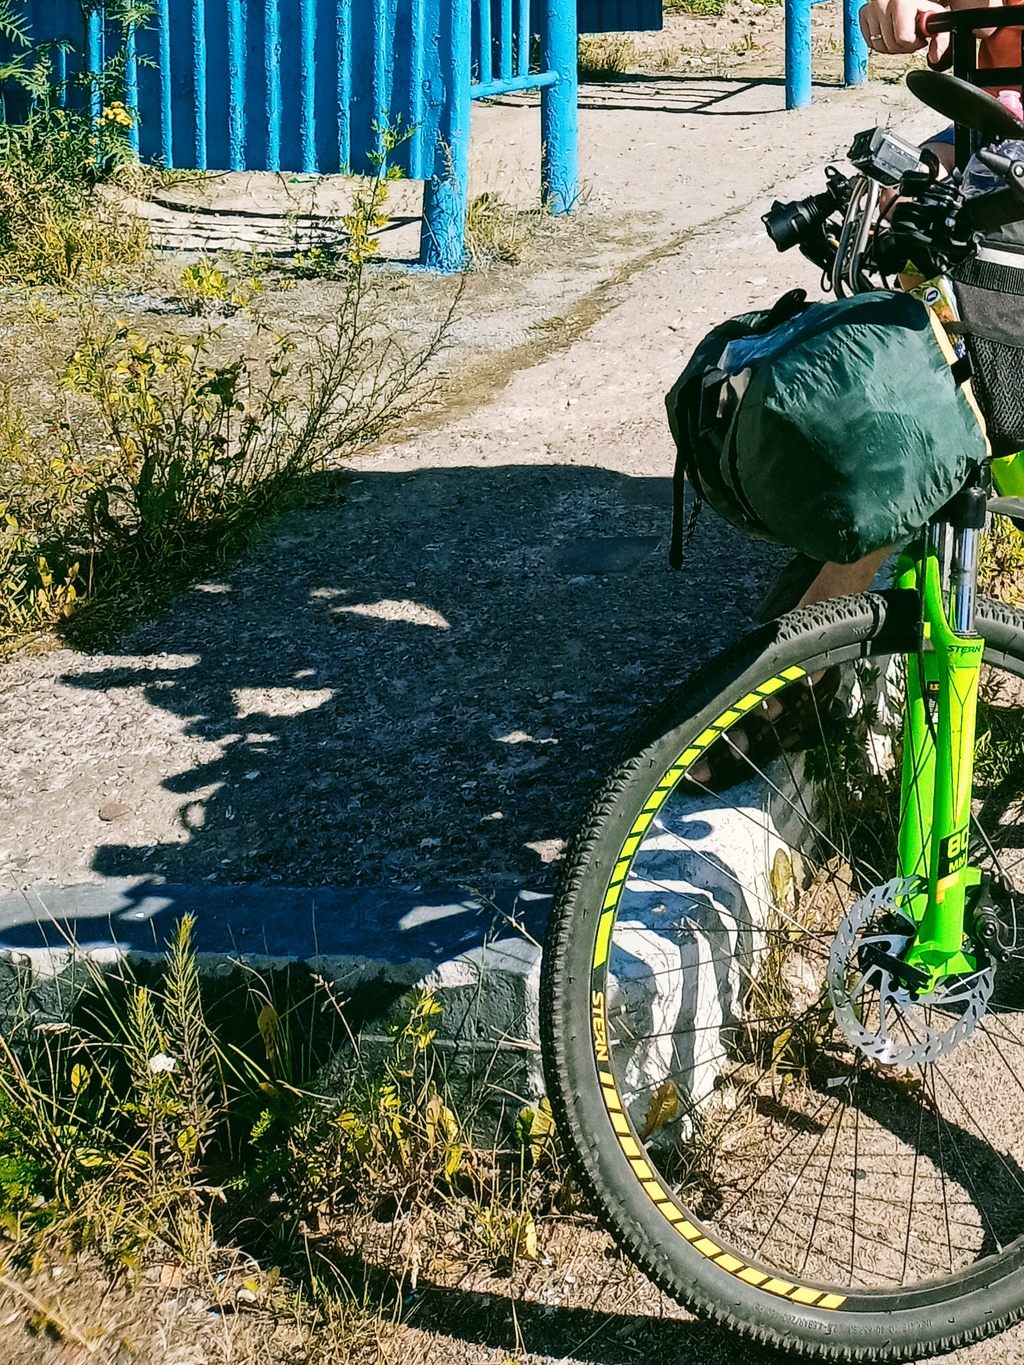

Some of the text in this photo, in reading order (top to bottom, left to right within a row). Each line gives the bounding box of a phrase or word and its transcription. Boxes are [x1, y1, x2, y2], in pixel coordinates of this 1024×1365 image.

[947, 645, 981, 657] STERN
[947, 826, 969, 859] 80
[592, 990, 609, 1061] STERN
